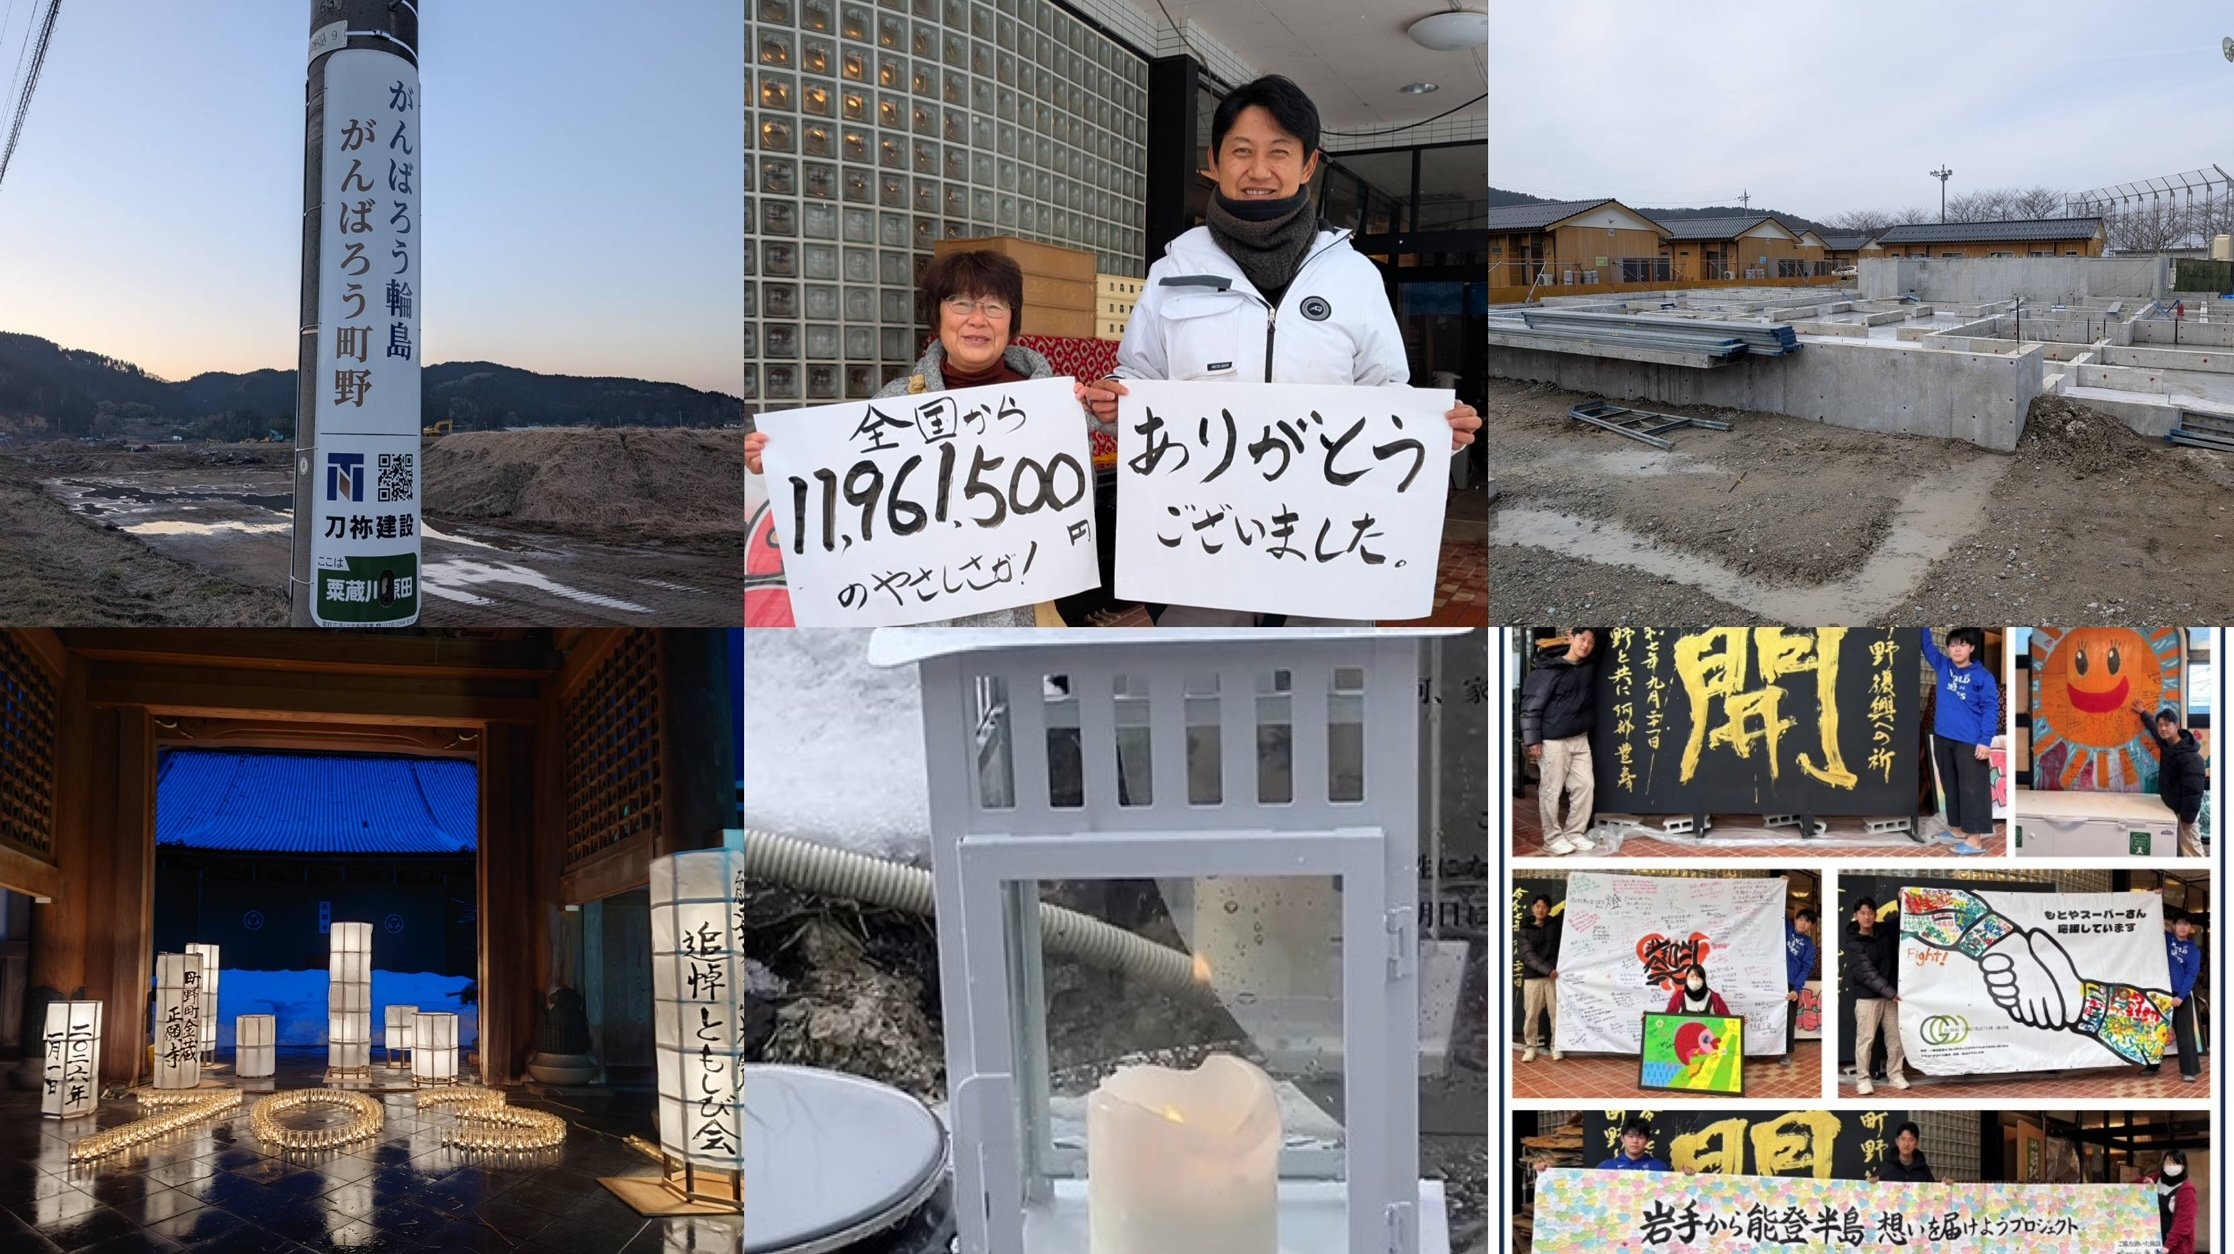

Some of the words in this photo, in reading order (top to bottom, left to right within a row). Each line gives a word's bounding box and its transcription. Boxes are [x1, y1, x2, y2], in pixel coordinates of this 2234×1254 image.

[385, 80, 414, 361] がんばろう輪島
[334, 119, 377, 408] がんばろう町野
[849, 394, 1027, 453] 全国から
[1127, 406, 1425, 493] ありがとう
[788, 441, 1086, 555] 11,961,500
[324, 513, 414, 540] 刀祢建設
[1066, 519, 1091, 546] 円
[1157, 503, 1408, 568] ございました。
[317, 556, 344, 568] ここは
[2044, 909, 2147, 920] もとやスーパーさん
[2057, 922, 2137, 934] 応援しています
[1907, 947, 1949, 967] Fight!
[682, 921, 741, 1155] 追悼ともしび会
[1640, 1198, 1865, 1247] 岩手から能登半島
[1877, 1210, 2079, 1246] 想いを届けようプロジェクト
